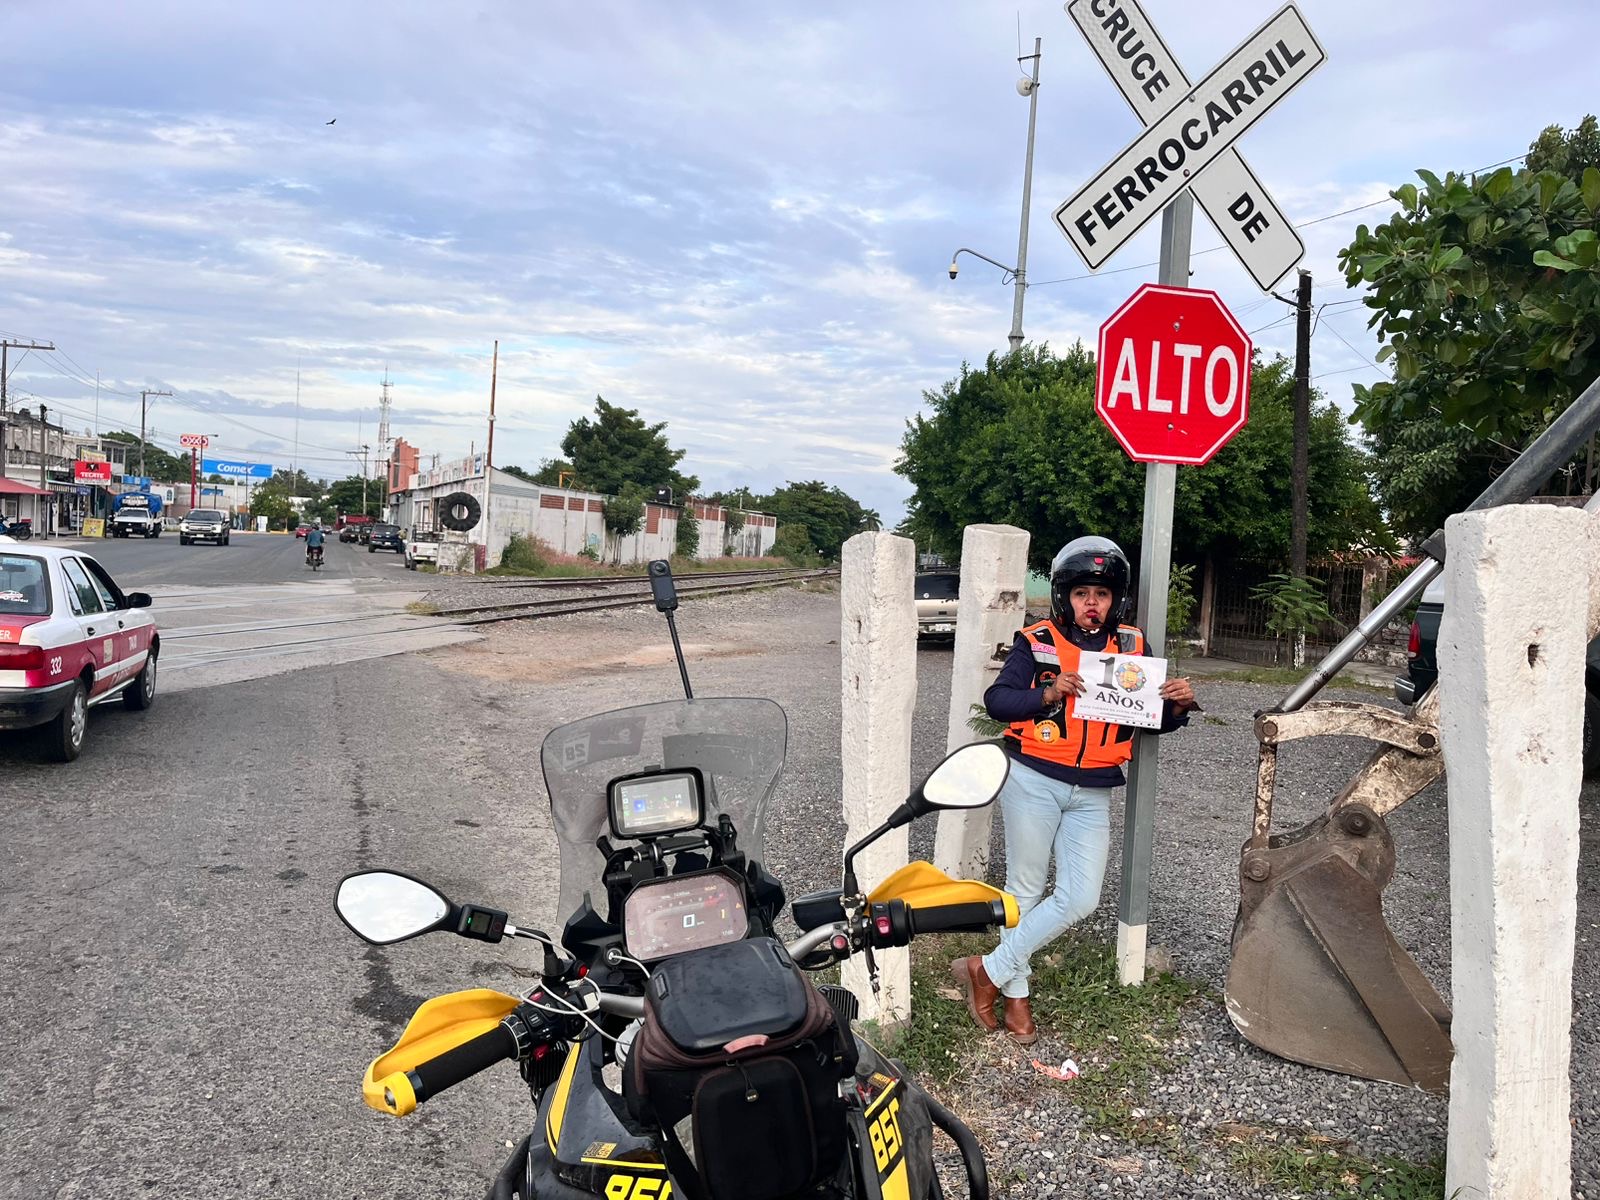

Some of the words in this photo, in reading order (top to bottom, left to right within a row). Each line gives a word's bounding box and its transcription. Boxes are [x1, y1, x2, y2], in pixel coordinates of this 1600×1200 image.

[1091, 0, 1170, 102] CRUCE
[1074, 39, 1306, 247] FERROCARRIL
[1227, 191, 1270, 244] DE
[1107, 337, 1239, 417] ALTO
[181, 436, 208, 446] OXXO
[217, 463, 255, 474] Comex
[50, 656, 62, 676] 332
[1095, 690, 1145, 711] AÑOS
[683, 914, 695, 928] 0
